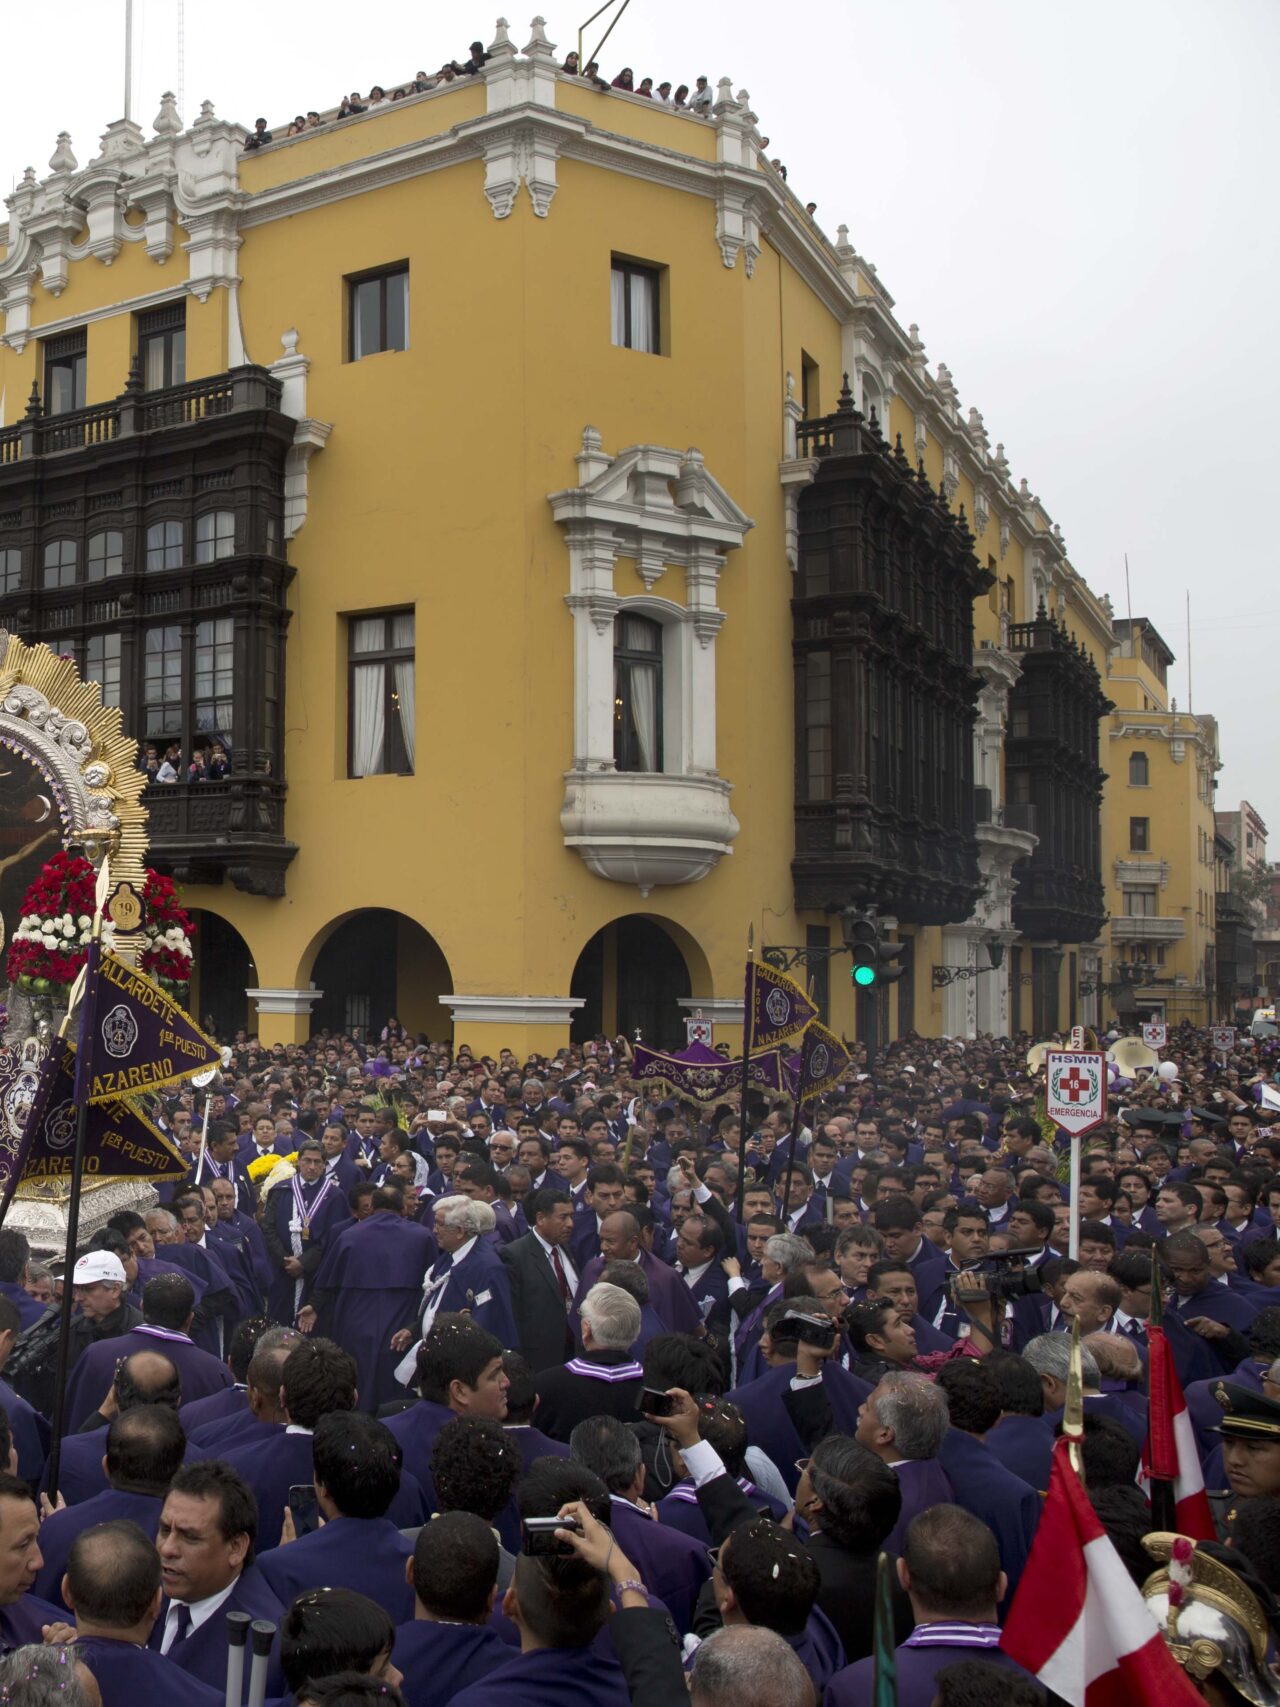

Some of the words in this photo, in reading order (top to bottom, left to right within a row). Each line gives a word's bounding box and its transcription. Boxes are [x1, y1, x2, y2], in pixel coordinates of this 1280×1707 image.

[118, 902, 132, 915] 19
[99, 958, 177, 1027] ALLARDETE
[174, 1036, 207, 1060] PUESTO
[1051, 1055, 1099, 1064] HSMN
[91, 1058, 173, 1096] AZARENO
[1069, 1080, 1079, 1089] 16
[120, 1141, 170, 1170] PUESTO
[19, 1156, 100, 1180] AZAREO
